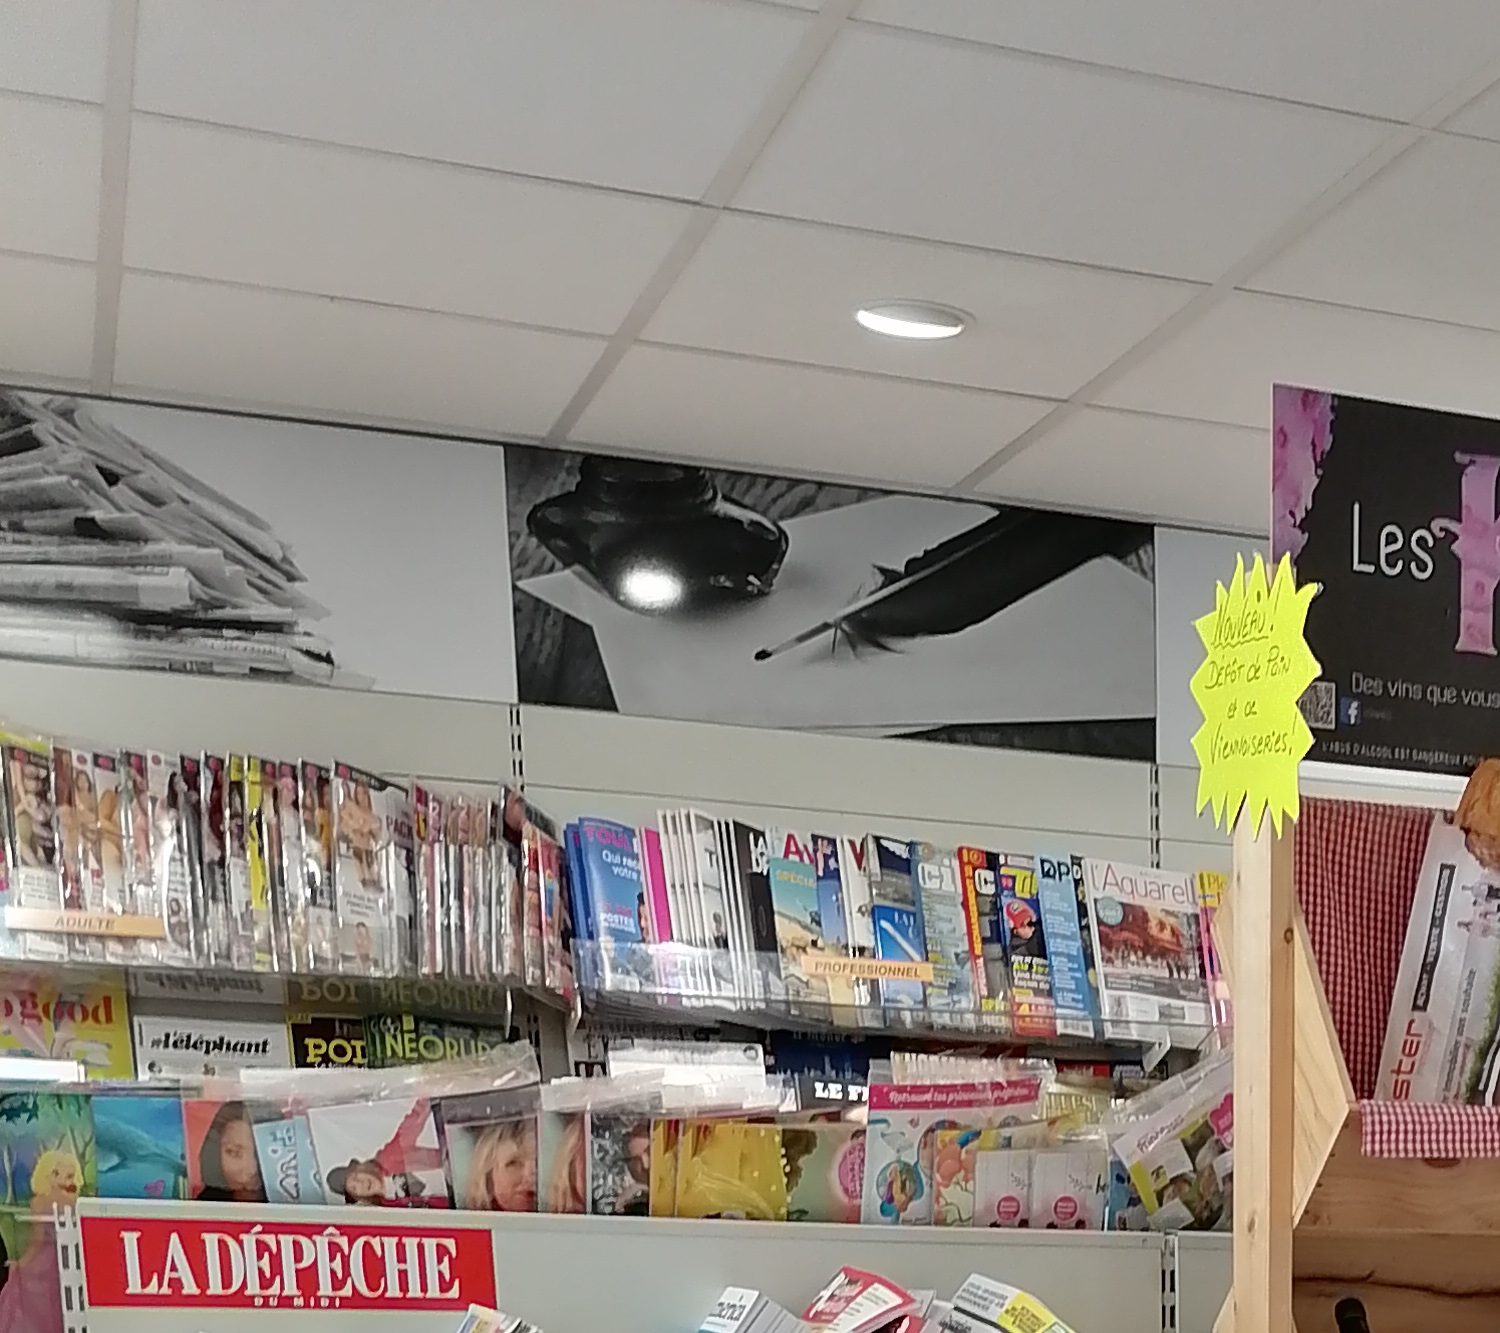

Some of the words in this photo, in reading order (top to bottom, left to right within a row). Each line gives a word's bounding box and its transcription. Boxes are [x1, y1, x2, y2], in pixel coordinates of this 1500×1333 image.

[1351, 500, 1436, 581] Les
[1352, 672, 1383, 696] Des
[1387, 679, 1423, 700] vins
[1427, 688, 1457, 706] que
[1460, 690, 1500, 709] vous
[55, 915, 116, 931] ADULTE
[813, 959, 922, 979] PROFESSIONNEL
[119, 1229, 202, 1299] LA
[201, 1222, 460, 1299] DÉPÊCHE
